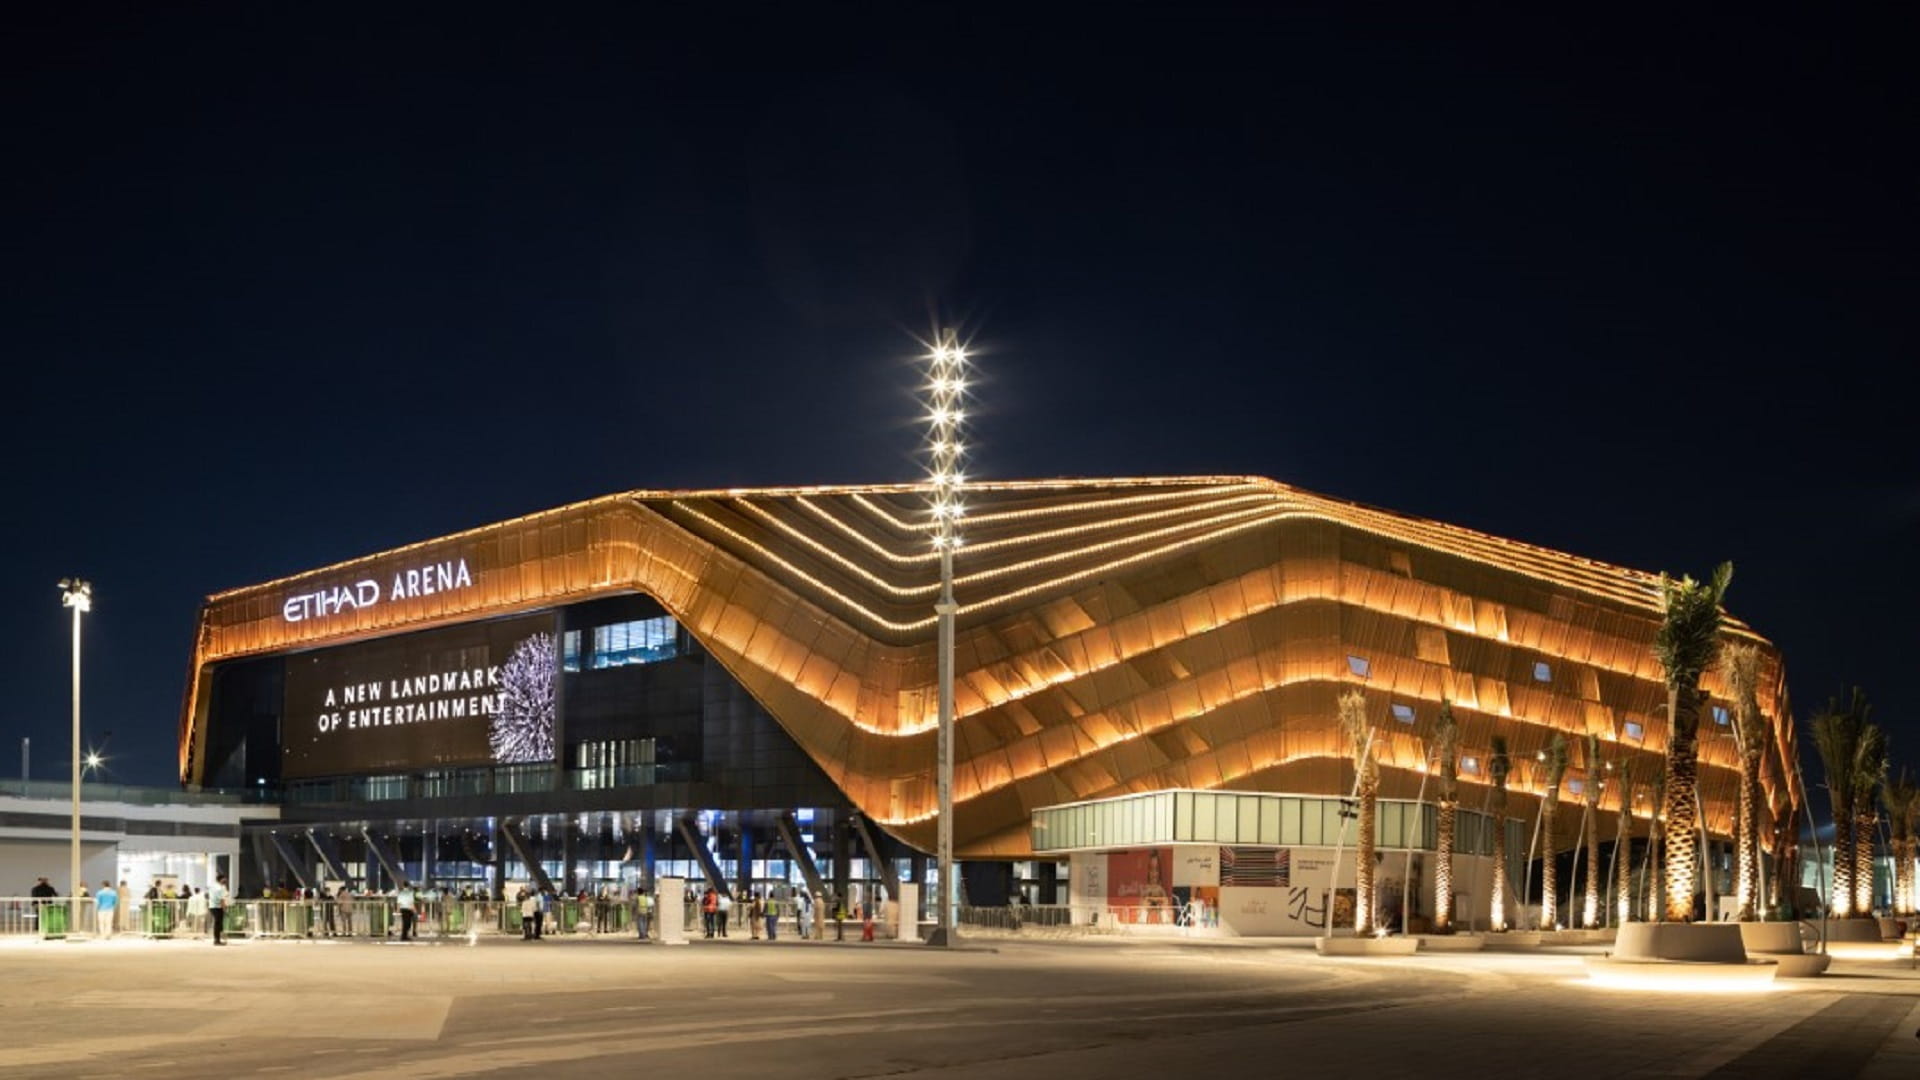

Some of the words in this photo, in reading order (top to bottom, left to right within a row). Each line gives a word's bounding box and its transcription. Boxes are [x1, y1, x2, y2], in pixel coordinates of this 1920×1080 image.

[283, 579, 380, 622] ETIHAD
[391, 558, 472, 601] ARENA
[325, 688, 336, 707] A
[345, 682, 382, 705] NEW
[391, 666, 500, 699] LANDMARK
[318, 714, 342, 733] OF
[349, 693, 507, 729] ENTERTAINMENT
